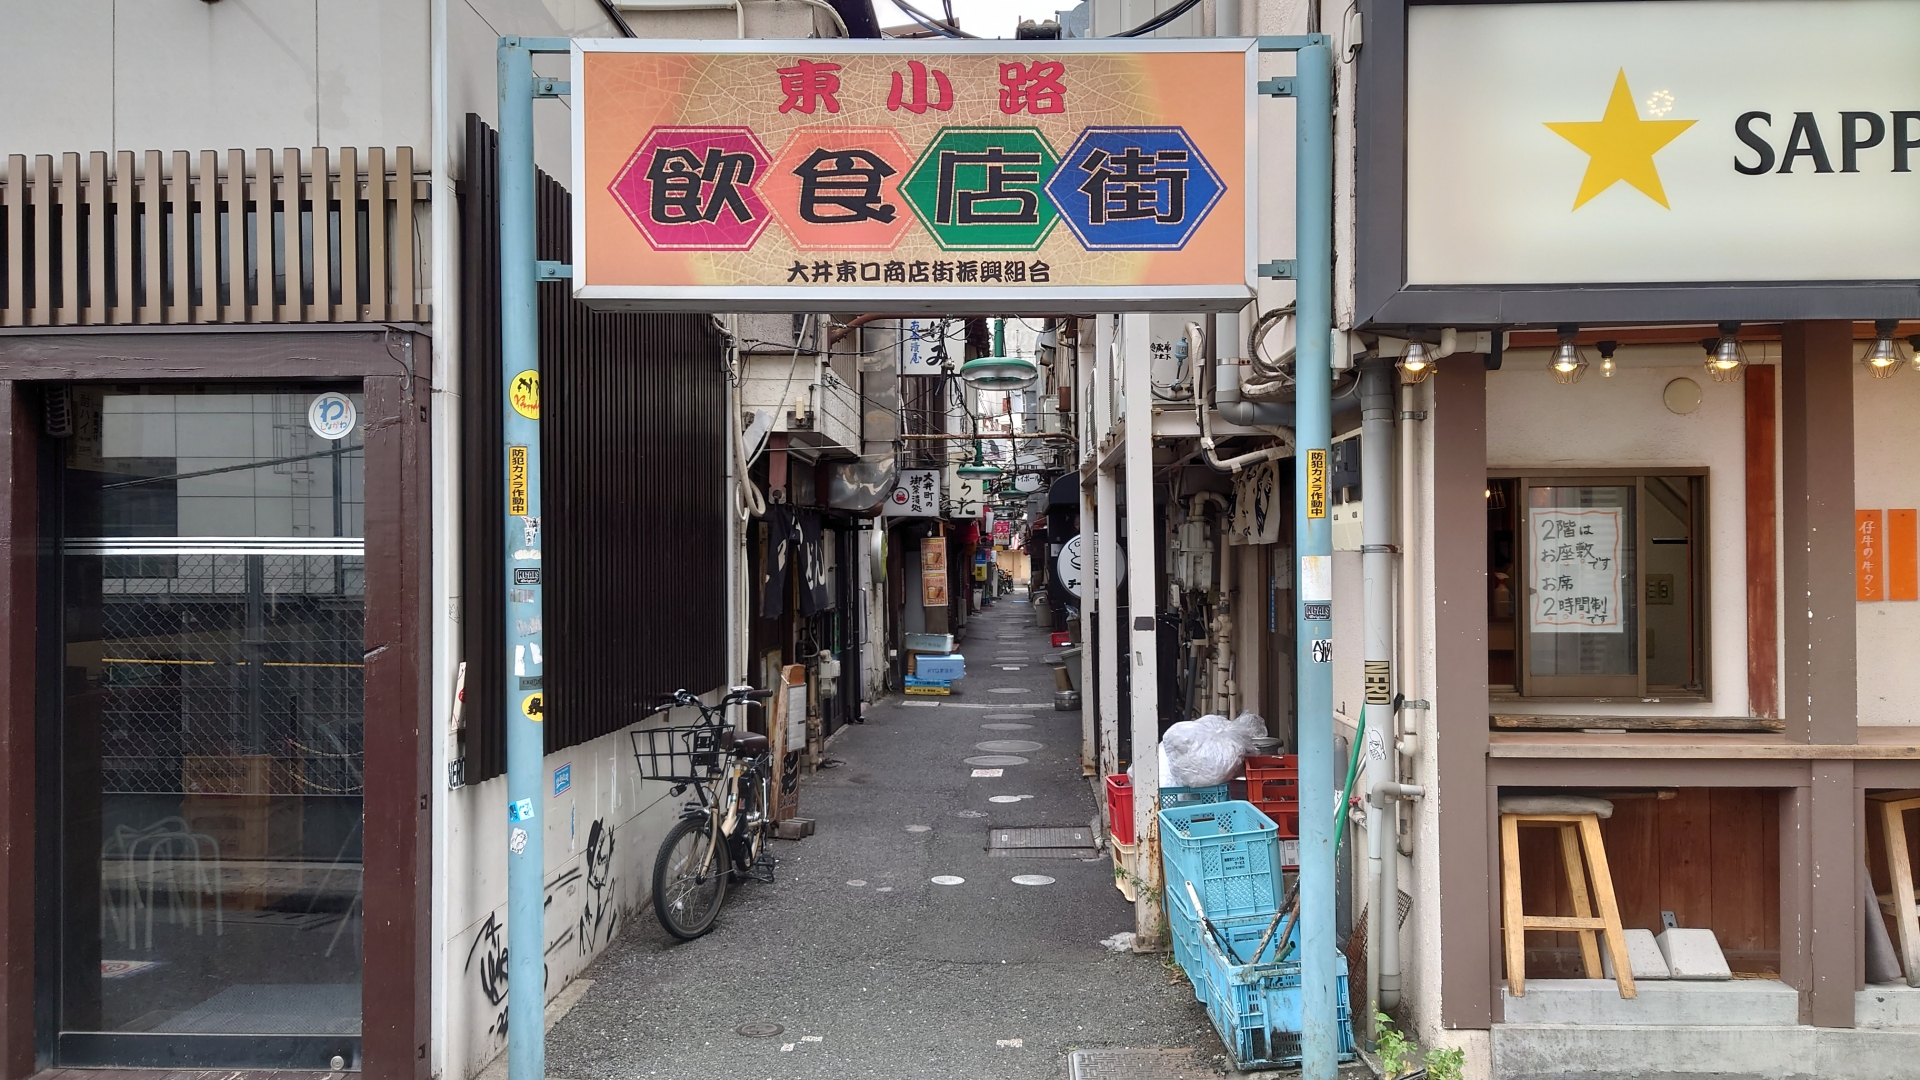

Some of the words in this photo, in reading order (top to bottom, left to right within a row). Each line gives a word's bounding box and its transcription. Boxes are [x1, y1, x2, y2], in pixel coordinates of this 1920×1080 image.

[777, 59, 1067, 115] 東小路
[645, 146, 1188, 226] 飲食店街
[787, 259, 1051, 284] 大井東口商店街振興組合
[320, 421, 348, 431] しながわ
[510, 447, 527, 514] 防犯カメラ作動中
[923, 472, 935, 508] 大井町の
[1310, 452, 1324, 516] 防犯カメラ作動中
[1541, 519, 1594, 541] 2階は
[1542, 575, 1574, 592] お席
[1365, 660, 1391, 705] NERO
